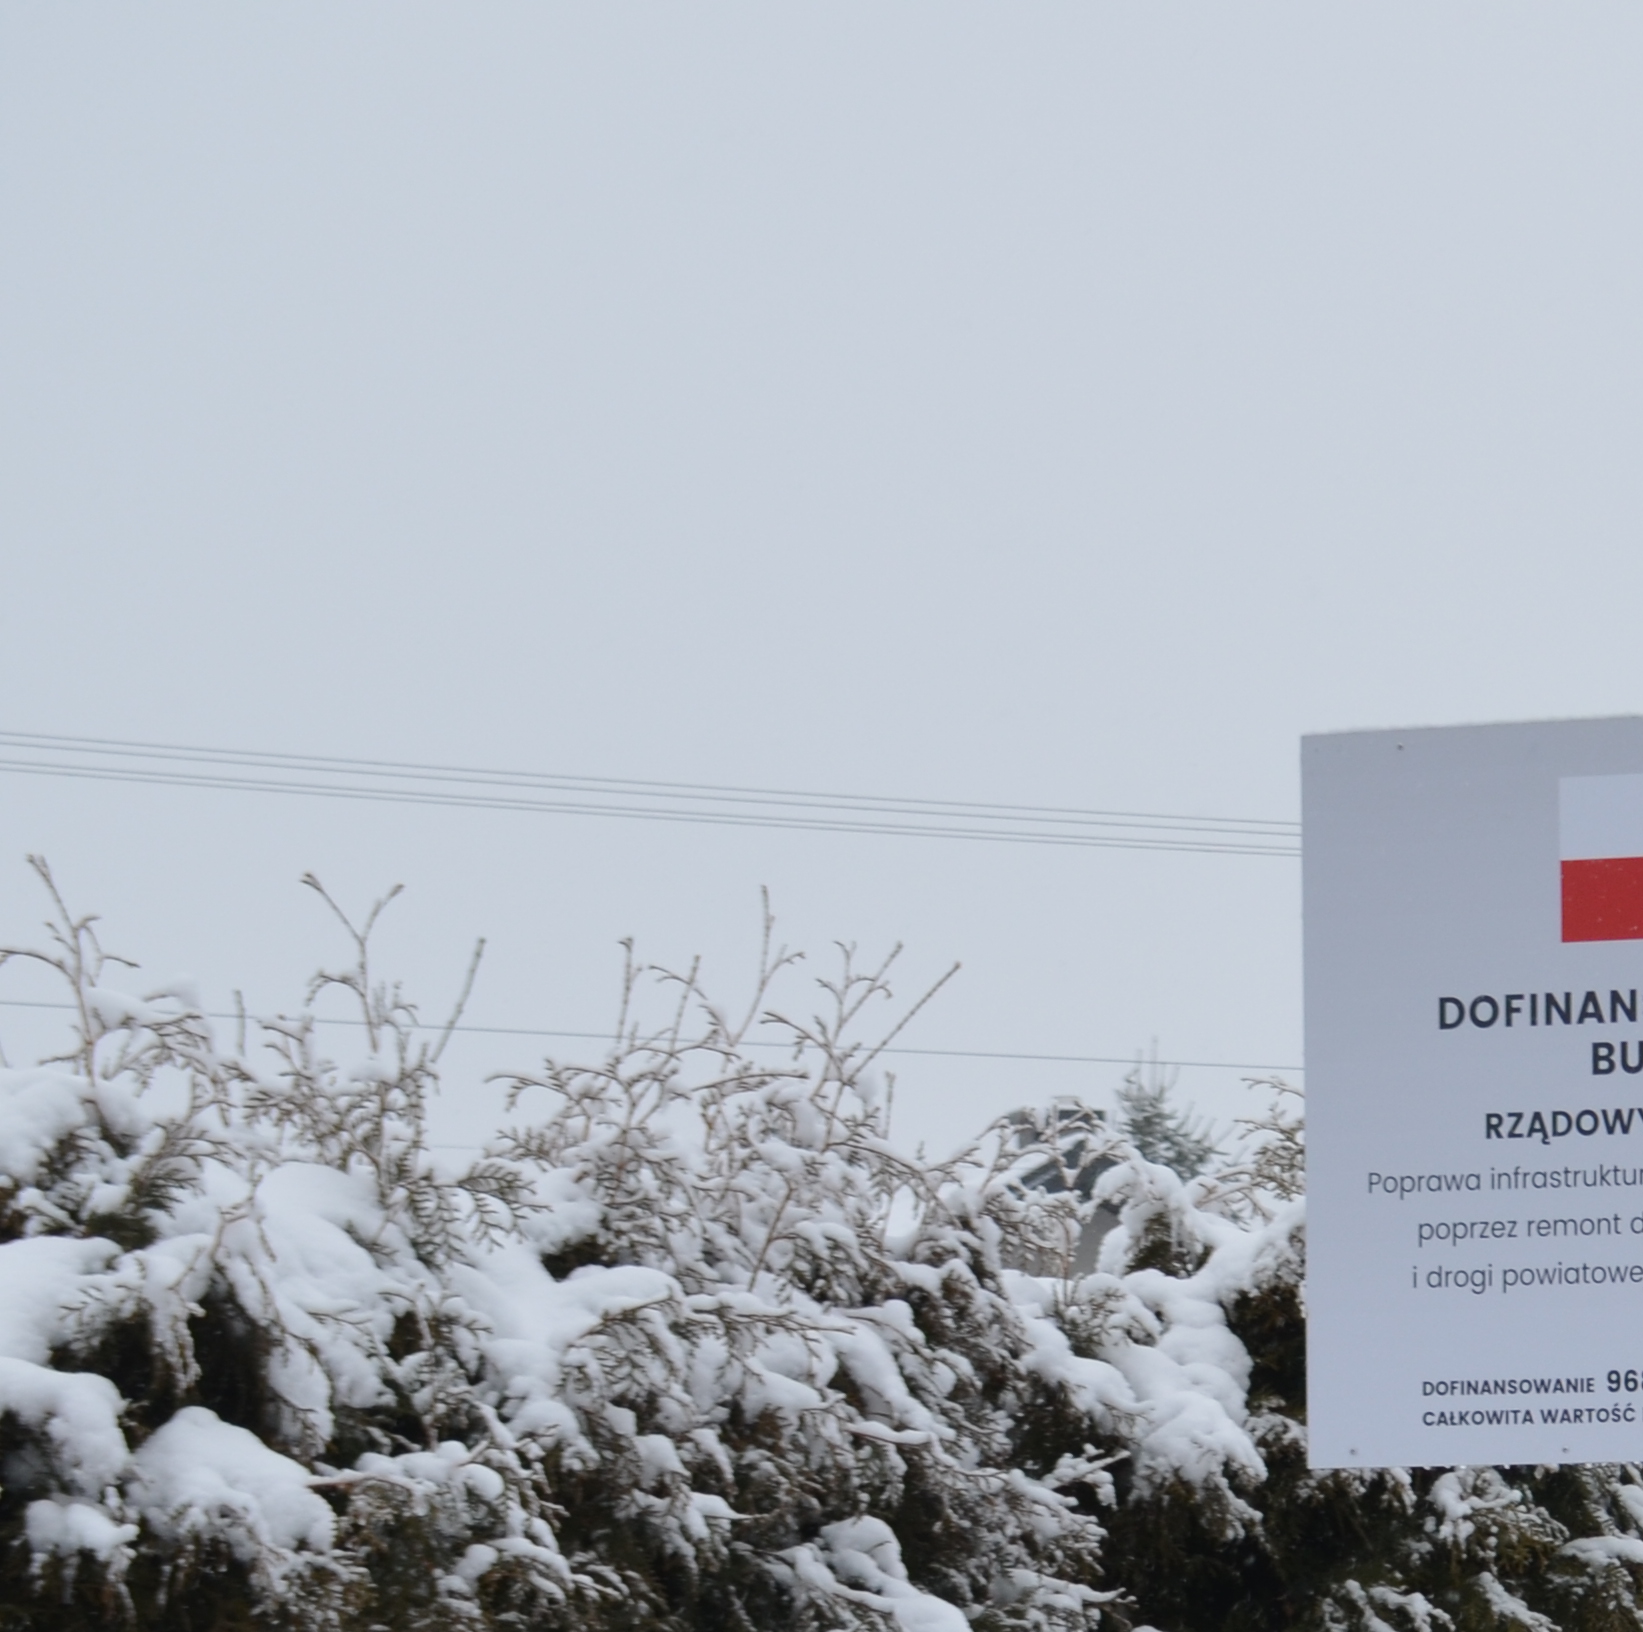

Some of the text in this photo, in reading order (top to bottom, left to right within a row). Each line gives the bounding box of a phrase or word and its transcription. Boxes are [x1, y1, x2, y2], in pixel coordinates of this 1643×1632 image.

[1368, 1172, 1482, 1201] Poprawa
[1417, 1220, 1518, 1249] poprzez
[1527, 1213, 1622, 1238] remont
[1412, 1265, 1418, 1289] i
[1425, 1263, 1493, 1295] drogi
[1421, 1377, 1596, 1397] DOFINANSOWANIE
[1421, 1408, 1535, 1427] CAŁKOWITA
[1539, 1402, 1636, 1425] WARTOŚĆ
